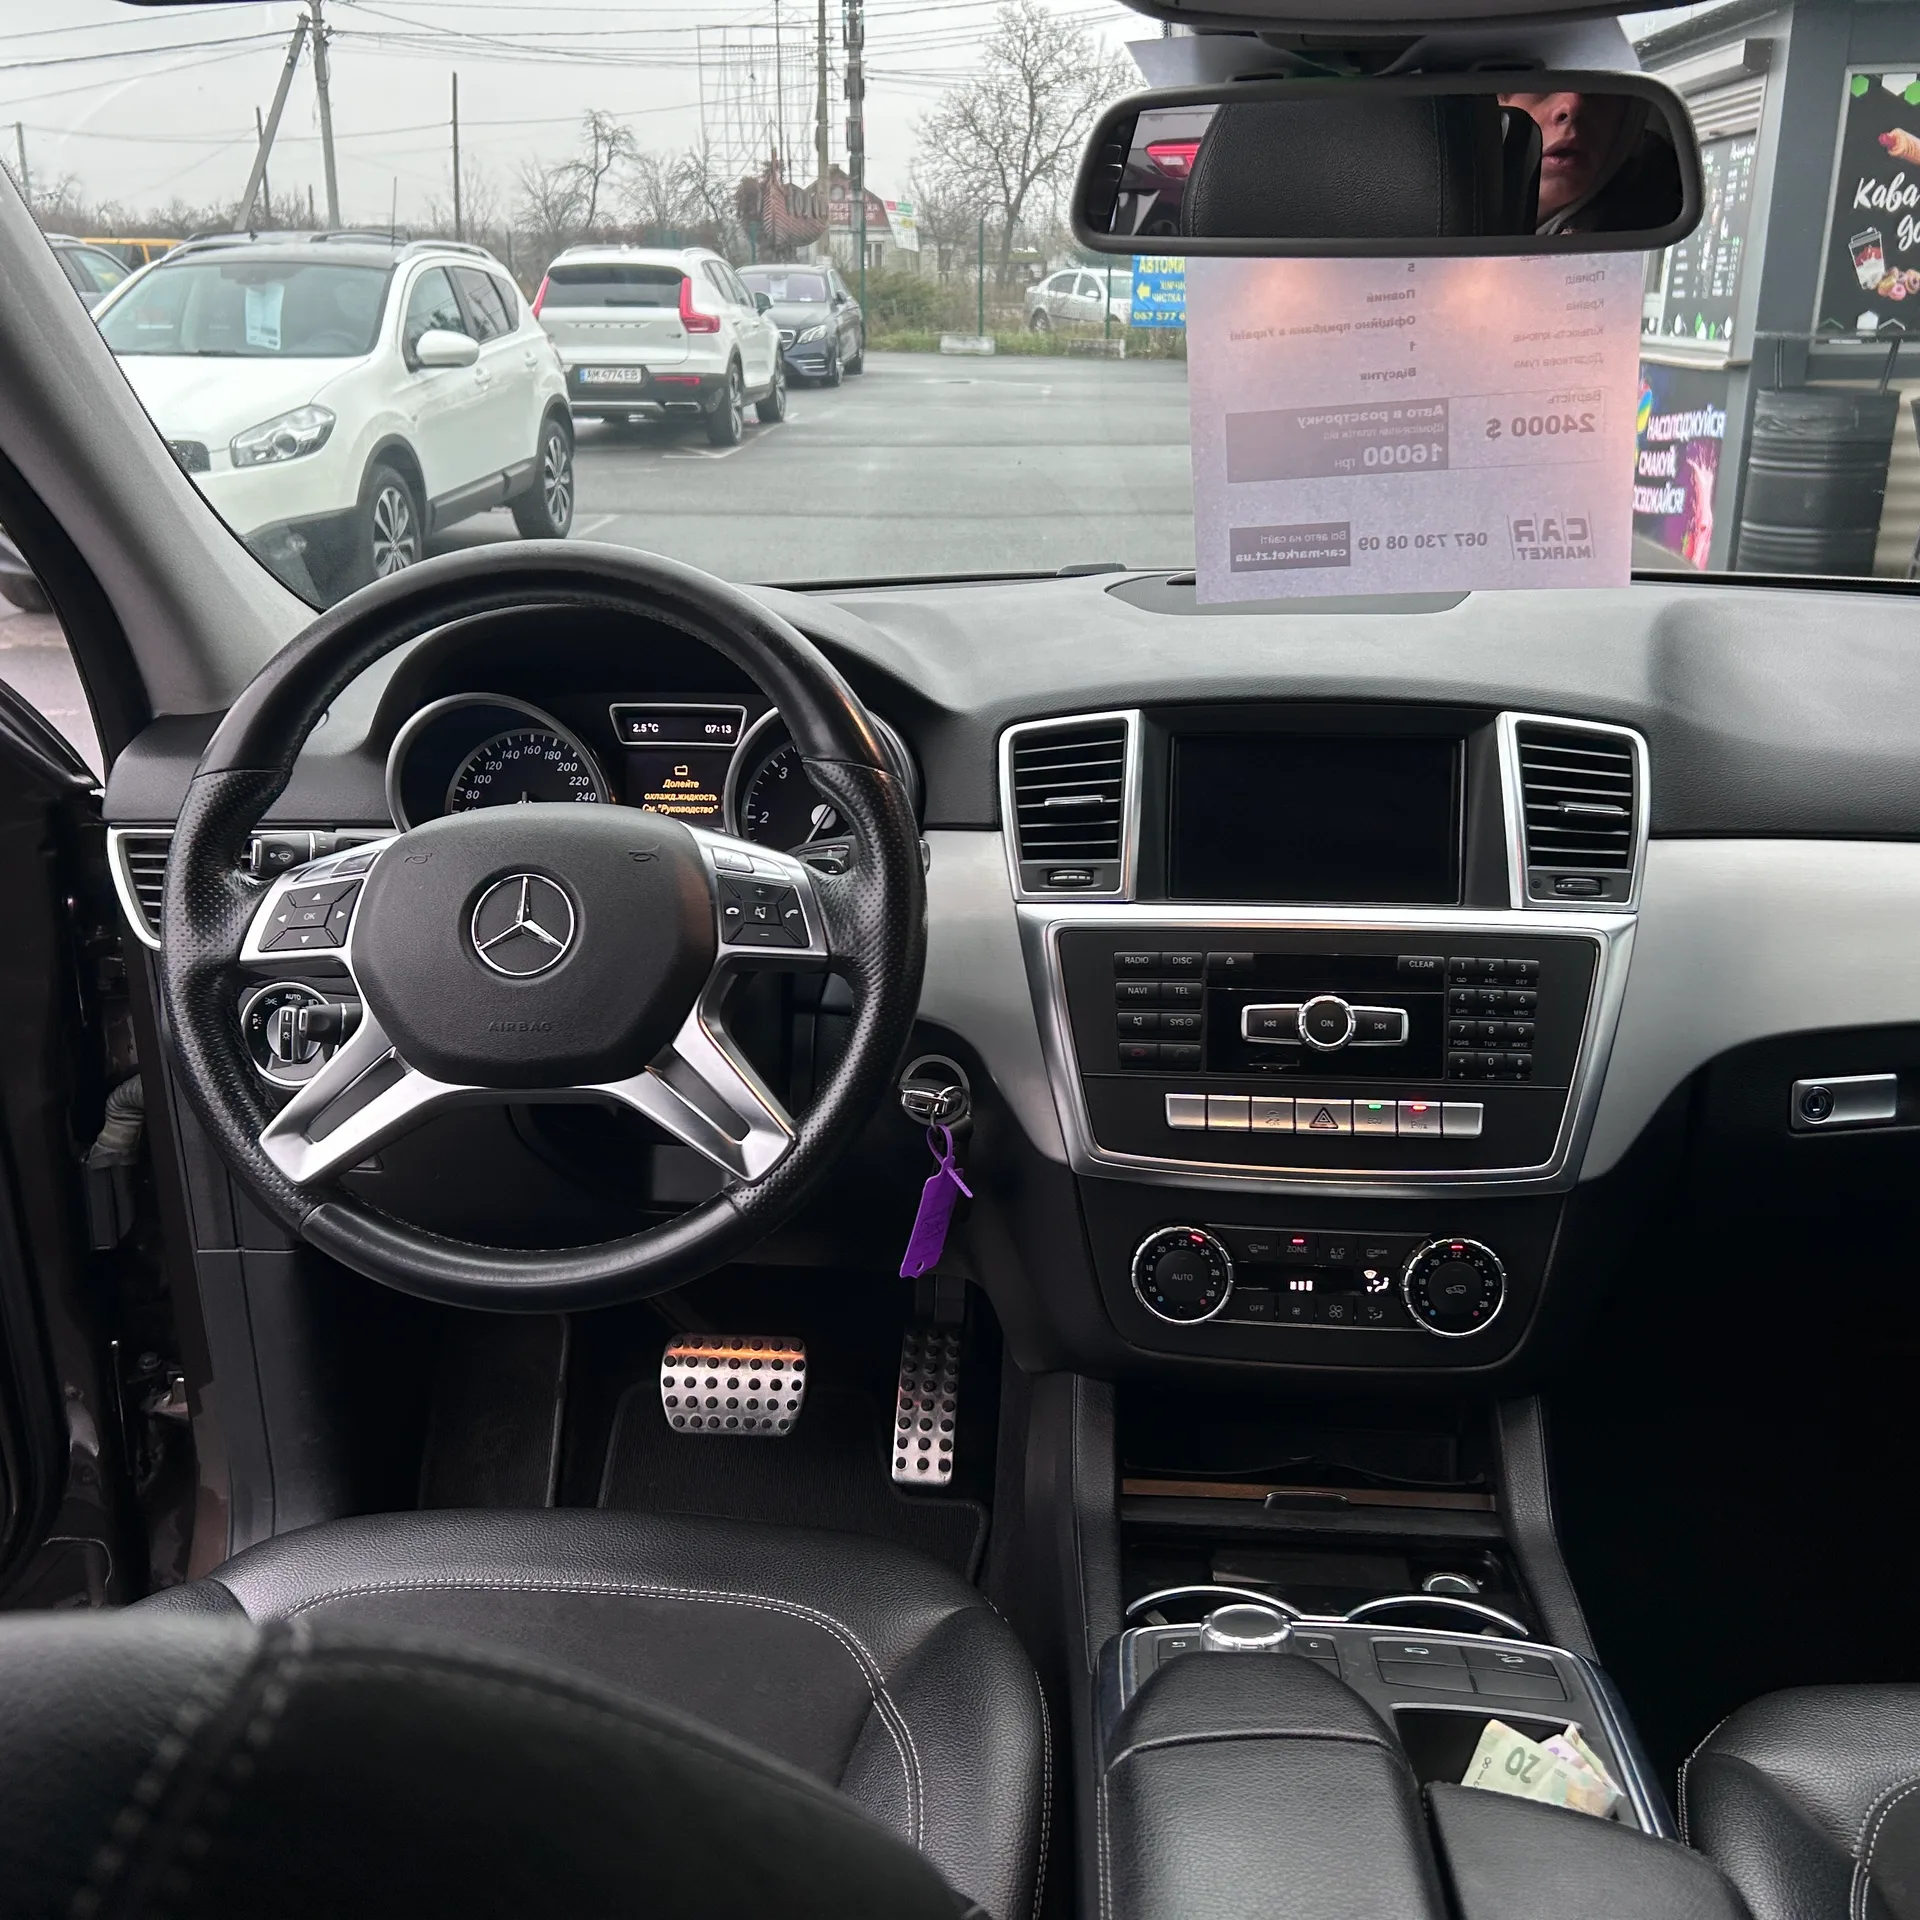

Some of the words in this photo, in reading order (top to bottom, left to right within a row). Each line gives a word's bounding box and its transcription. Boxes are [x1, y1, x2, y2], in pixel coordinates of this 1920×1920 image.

[632, 722, 659, 733] 2.5°C
[704, 724, 732, 734] 07:13
[523, 745, 541, 755] 160
[501, 750, 520, 760] 140
[544, 750, 561, 760] 180
[485, 761, 502, 771] 120
[556, 762, 578, 772] 200
[778, 766, 788, 780] 3
[473, 774, 492, 785] 100
[568, 776, 589, 786] 220
[662, 778, 699, 789] Долейте
[465, 790, 480, 800] 80
[575, 792, 596, 801] 240
[644, 793, 718, 802] охлажд.жидкость
[642, 803, 657, 813] См.
[658, 804, 719, 814] "Руководство"
[759, 811, 769, 823] 2
[1124, 956, 1149, 964] RADIO
[1172, 957, 1193, 965] DISC
[1408, 960, 1435, 968] CLEAR
[1488, 963, 1495, 971] 2
[1520, 964, 1527, 972] 3
[1127, 987, 1148, 995] NAVI
[1489, 994, 1495, 1002] 5
[487, 1021, 552, 1032] AIRBAG
[1320, 1019, 1334, 1027] ON
[1488, 1026, 1495, 1034] 8
[1518, 1027, 1525, 1035] 9
[1286, 1246, 1308, 1254] ZONE
[1171, 1273, 1193, 1281] AUTO
[1249, 1304, 1265, 1312] OFF
[1479, 1300, 1489, 1308] 28
[1505, 1746, 1541, 1784] 20
